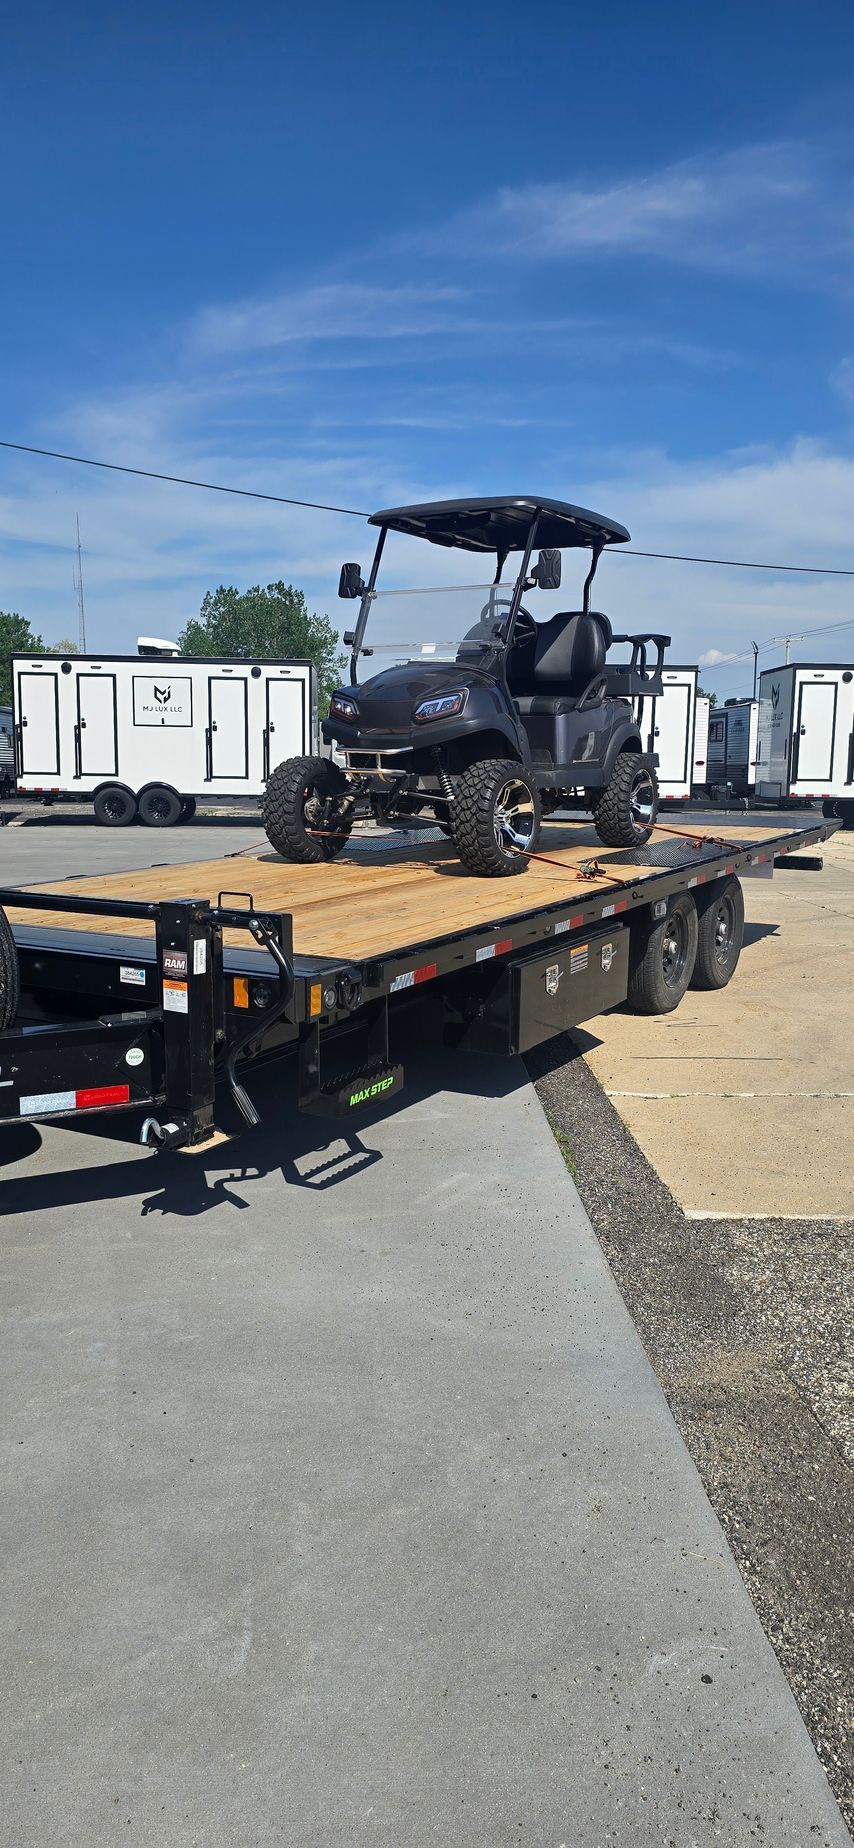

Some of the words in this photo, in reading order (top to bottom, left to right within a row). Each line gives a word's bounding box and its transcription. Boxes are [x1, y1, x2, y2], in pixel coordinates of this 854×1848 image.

[164, 958, 186, 970] RAM
[350, 1087, 370, 1106] MAX
[371, 1076, 393, 1096] STEP
